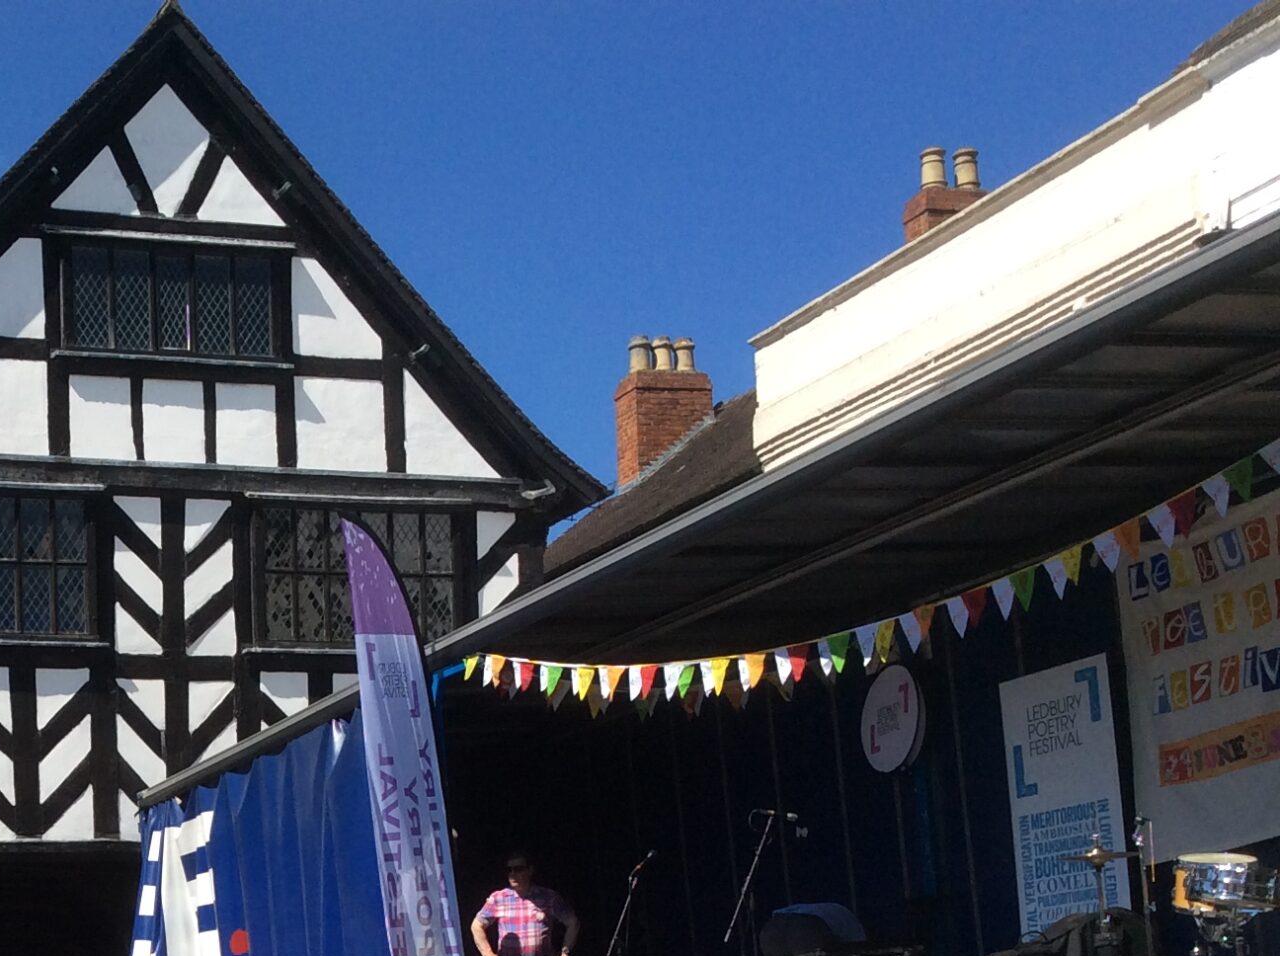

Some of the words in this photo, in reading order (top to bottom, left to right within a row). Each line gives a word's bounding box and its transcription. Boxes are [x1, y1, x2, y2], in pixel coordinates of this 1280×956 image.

[1026, 694, 1082, 723] LEDBURY
[1027, 714, 1077, 740] POETRY
[1029, 731, 1083, 757] FESTIVAL
[1030, 801, 1097, 830] MERITORIOUS
[1018, 815, 1037, 905] VERSIFICATION
[1035, 849, 1095, 879] BOHEMIA
